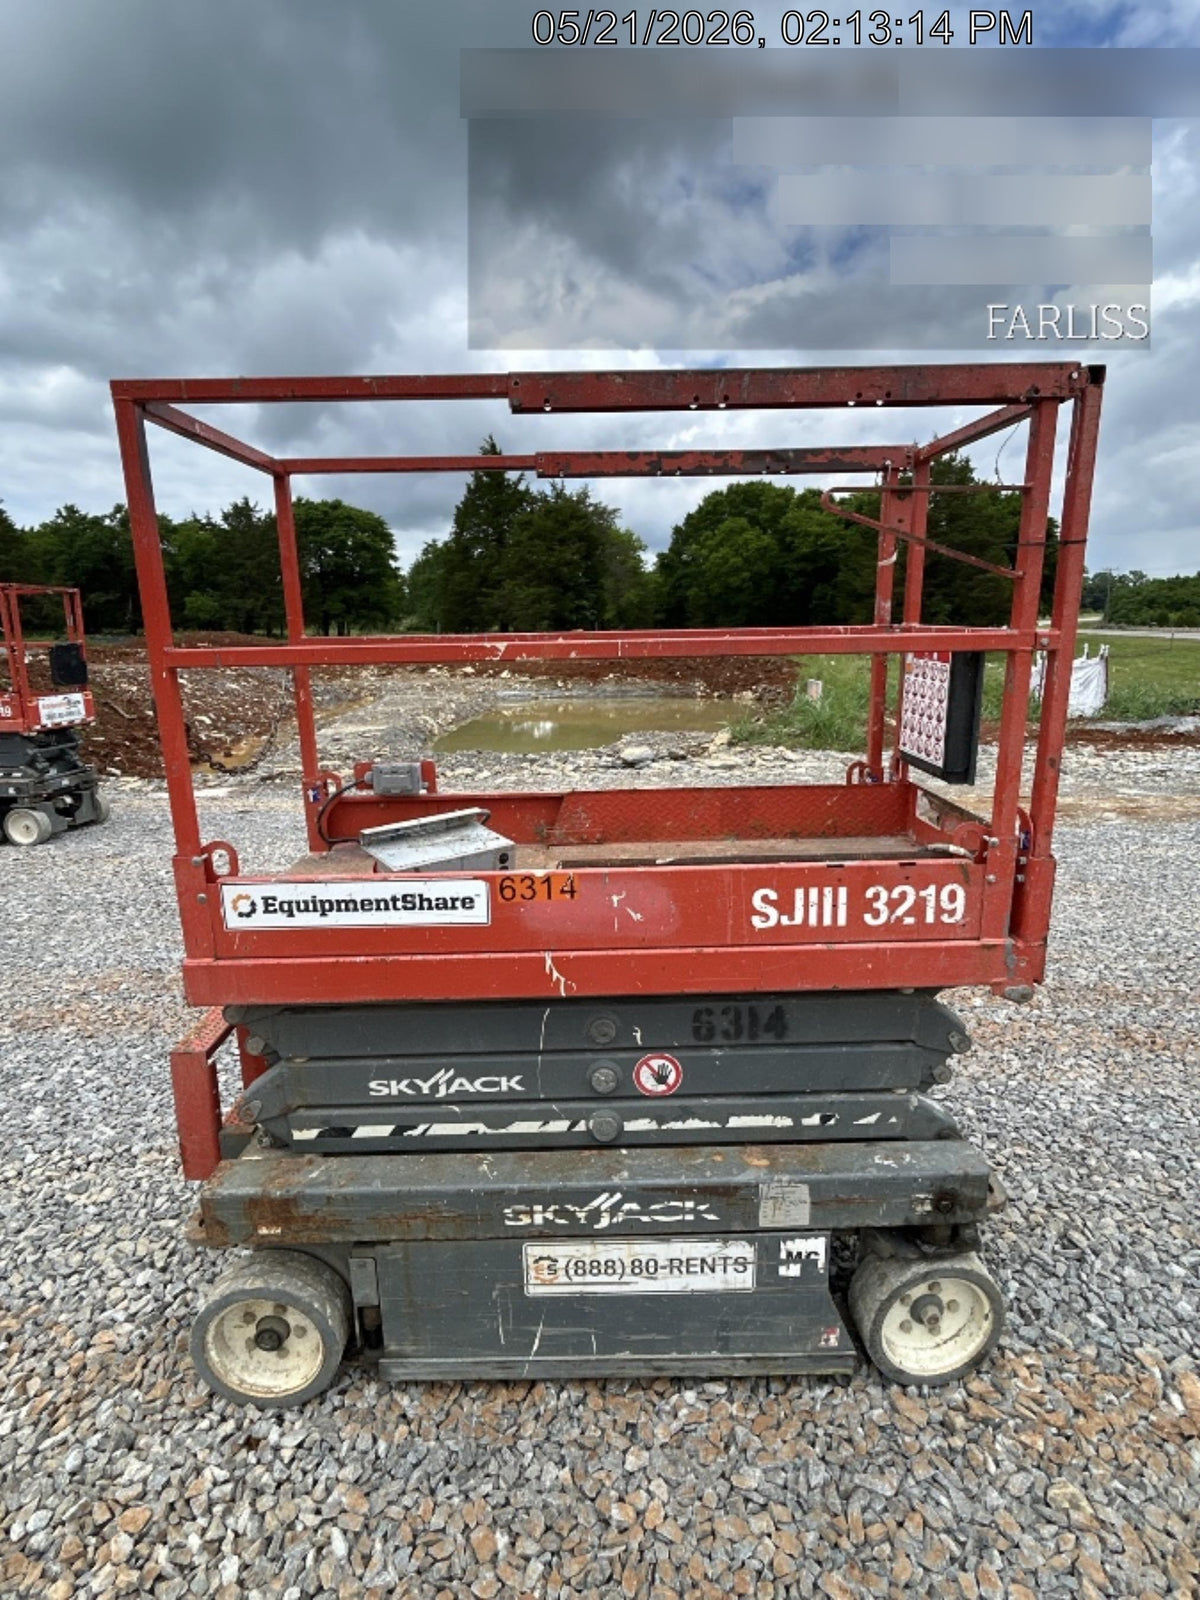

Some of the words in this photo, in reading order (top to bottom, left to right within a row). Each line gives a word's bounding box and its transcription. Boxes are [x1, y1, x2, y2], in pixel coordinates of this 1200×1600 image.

[499, 875, 576, 902] 6314
[261, 894, 476, 917] EquipmentShare
[863, 883, 966, 926] 3219
[692, 1005, 789, 1041] 6314
[368, 1068, 525, 1098] SKYJACK
